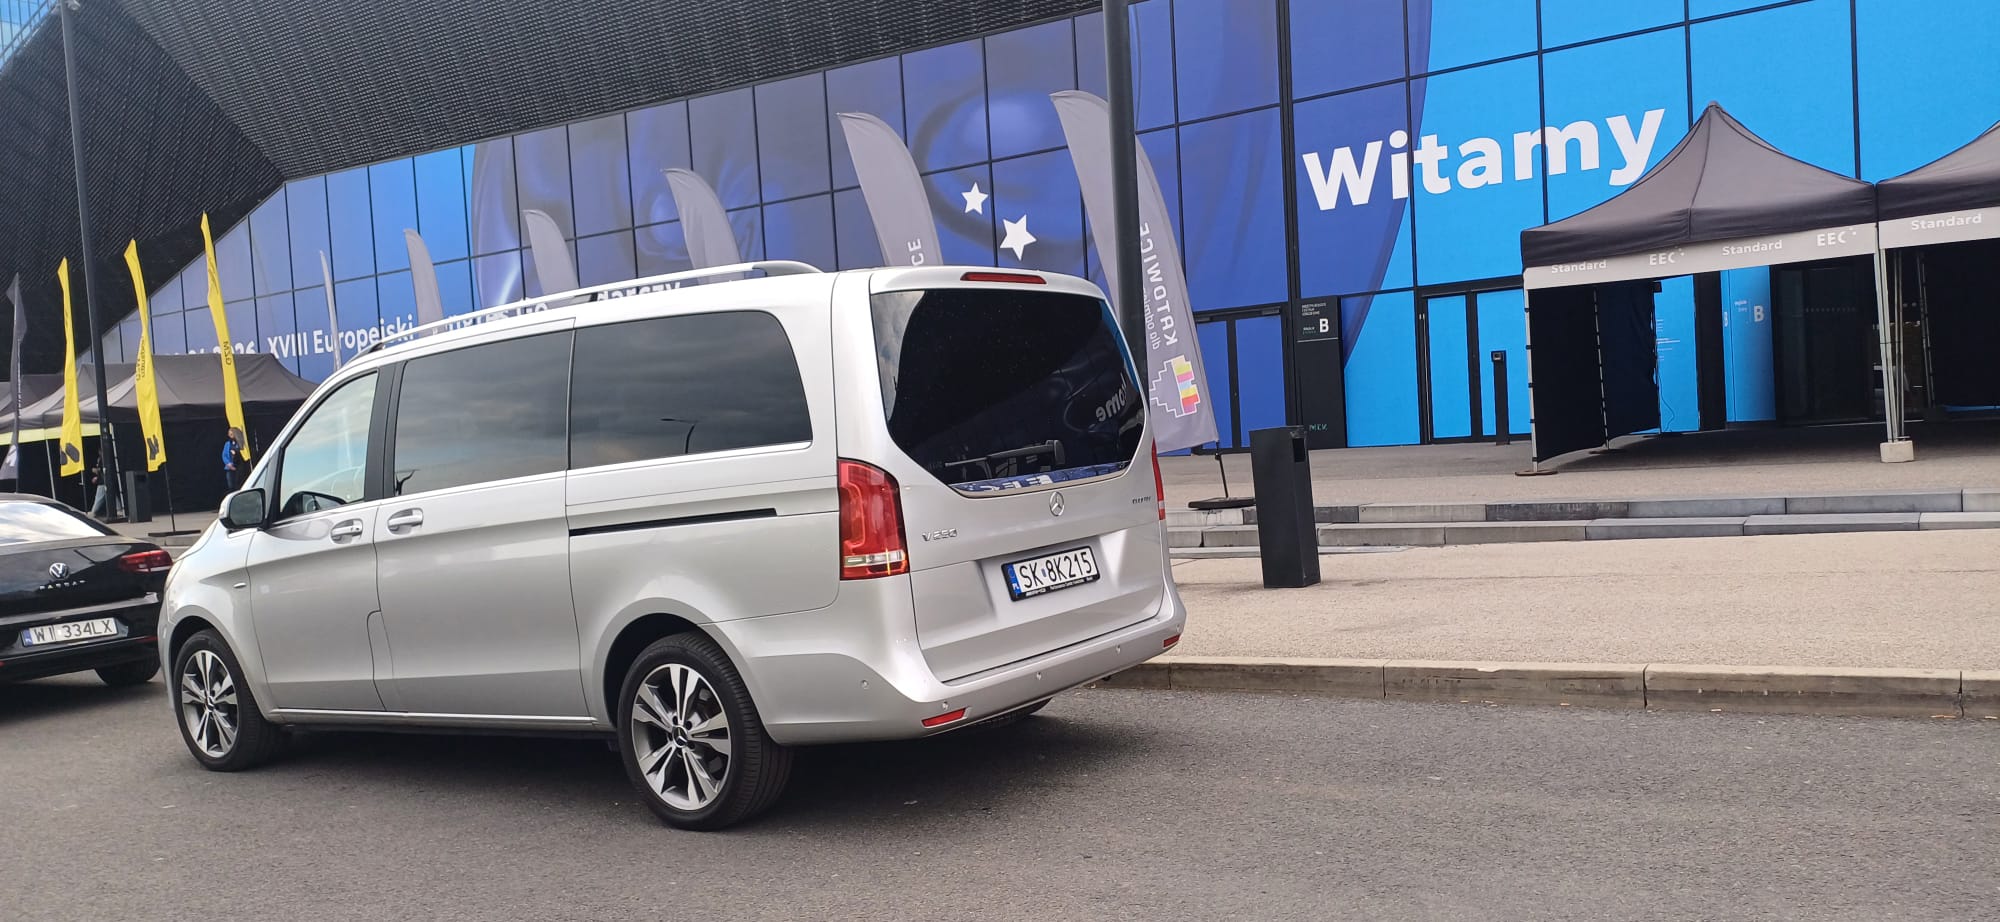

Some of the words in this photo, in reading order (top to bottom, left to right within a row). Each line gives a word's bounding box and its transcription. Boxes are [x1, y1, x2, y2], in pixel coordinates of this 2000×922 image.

[1302, 108, 1665, 211] Witamy
[1911, 213, 1982, 230] Standard
[1551, 259, 1607, 273] Standard
[1722, 240, 1783, 256] Standard
[1816, 231, 1847, 246] EEC
[1319, 318, 1329, 333] B
[1754, 305, 1765, 322] B
[267, 331, 308, 359] XVIII
[313, 313, 414, 354] Europejski
[1020, 562, 1044, 588] SK
[1046, 552, 1092, 582] 8K215
[62, 619, 113, 638] 334LX
